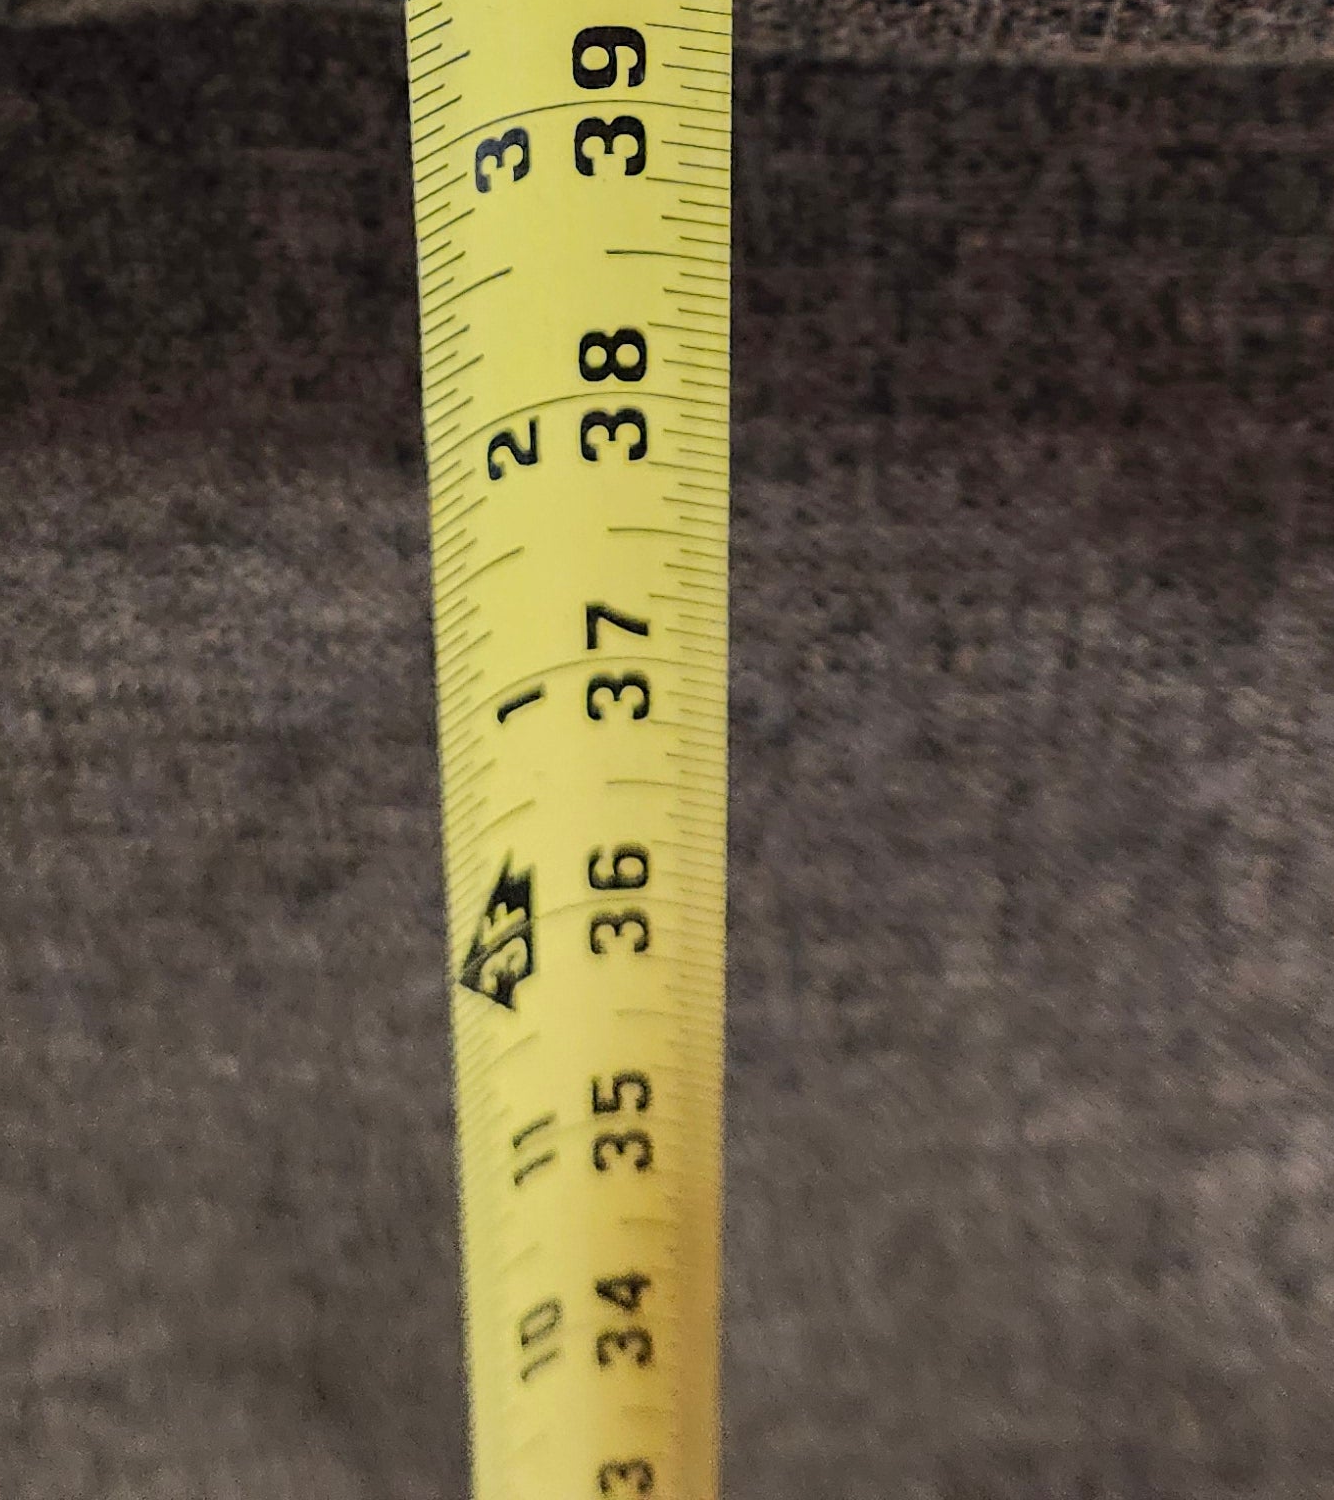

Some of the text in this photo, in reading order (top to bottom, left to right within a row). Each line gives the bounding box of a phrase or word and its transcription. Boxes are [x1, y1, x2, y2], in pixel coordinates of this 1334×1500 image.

[572, 25, 647, 177] 39
[474, 126, 530, 193] 3
[579, 327, 648, 462] 38
[487, 416, 539, 482] 2
[496, 685, 545, 724] 1
[586, 601, 650, 721] 37
[589, 842, 651, 955] 36
[512, 1113, 557, 1187] 11
[592, 1068, 654, 1173] 35
[520, 1296, 562, 1382] 10
[594, 1270, 654, 1369] 34
